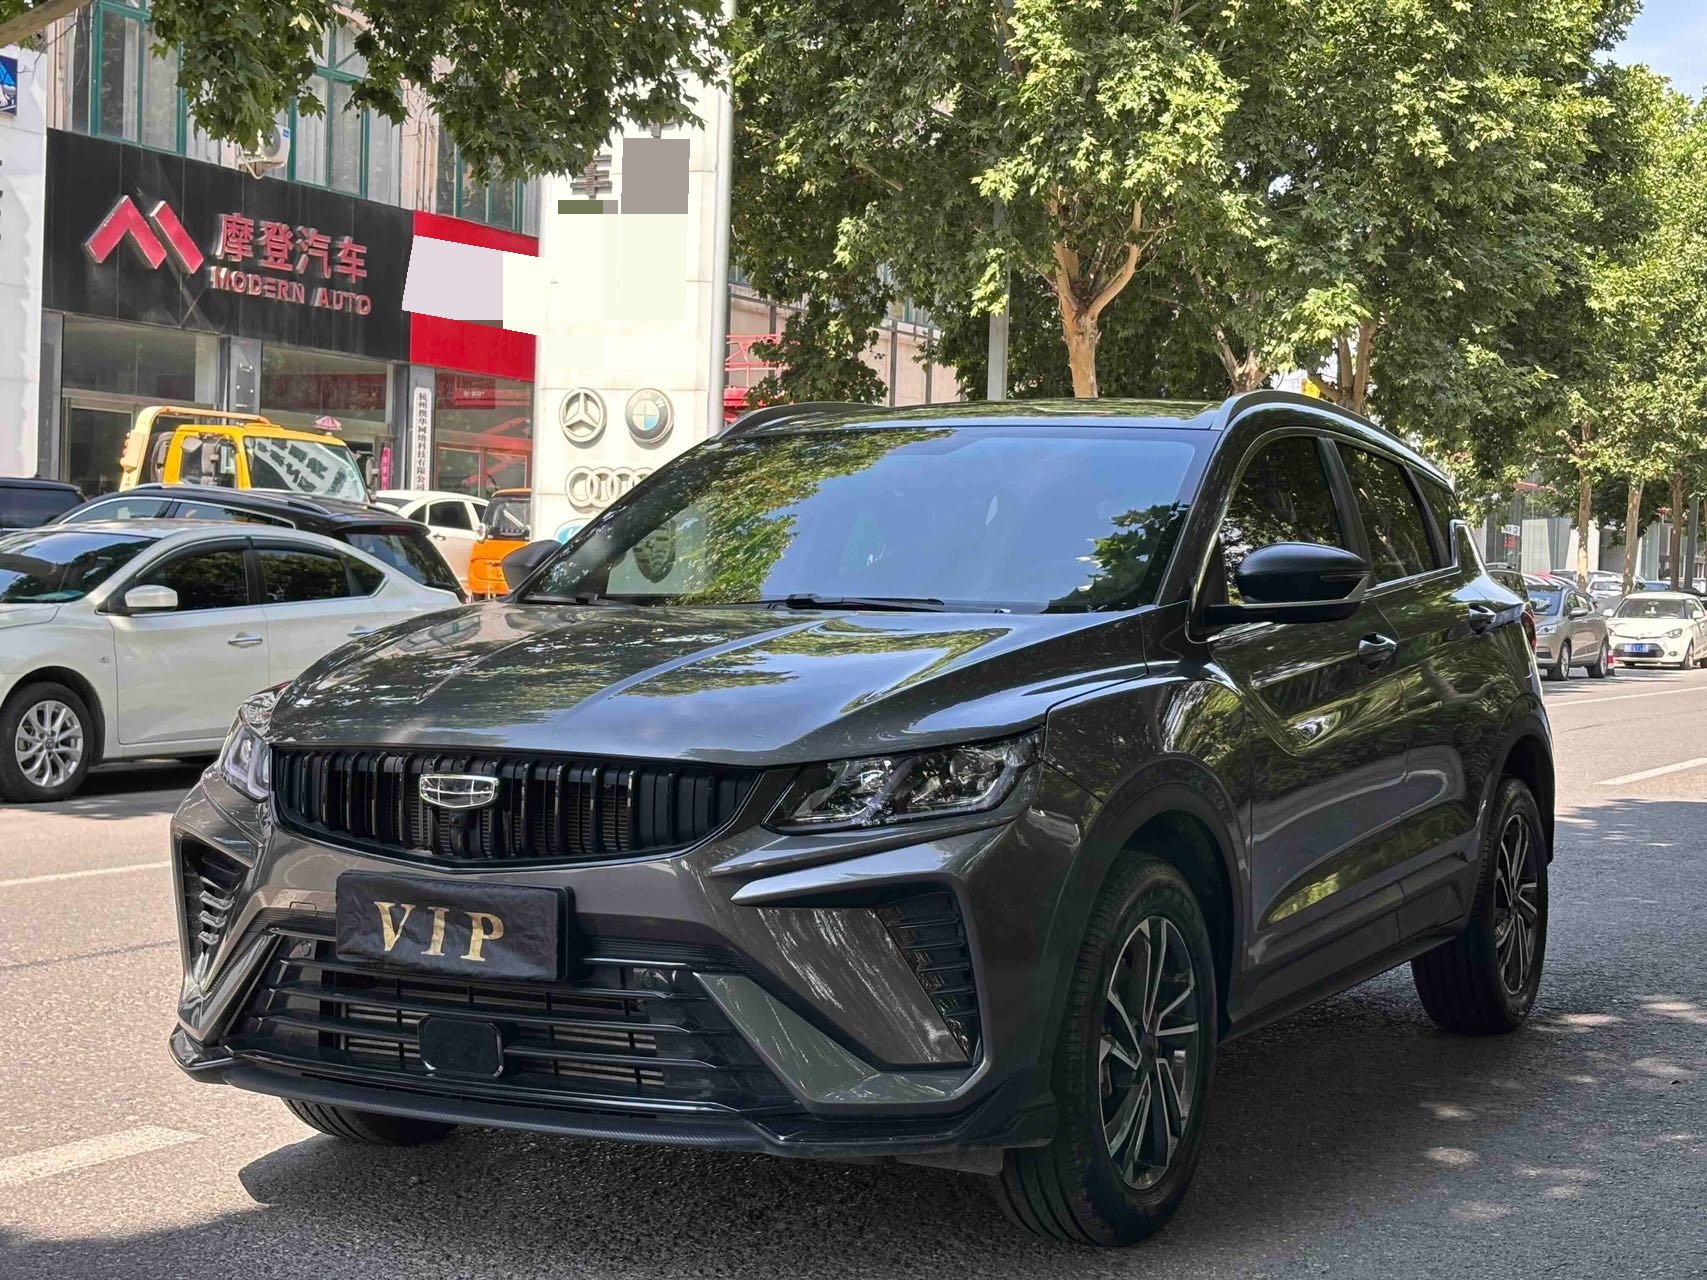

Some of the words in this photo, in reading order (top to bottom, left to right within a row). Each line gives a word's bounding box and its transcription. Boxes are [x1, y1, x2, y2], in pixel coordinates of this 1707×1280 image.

[212, 212, 368, 284] 摩登汽车
[210, 266, 305, 304] MODERN
[312, 287, 372, 316] AUTO
[373, 901, 505, 962] VIP
